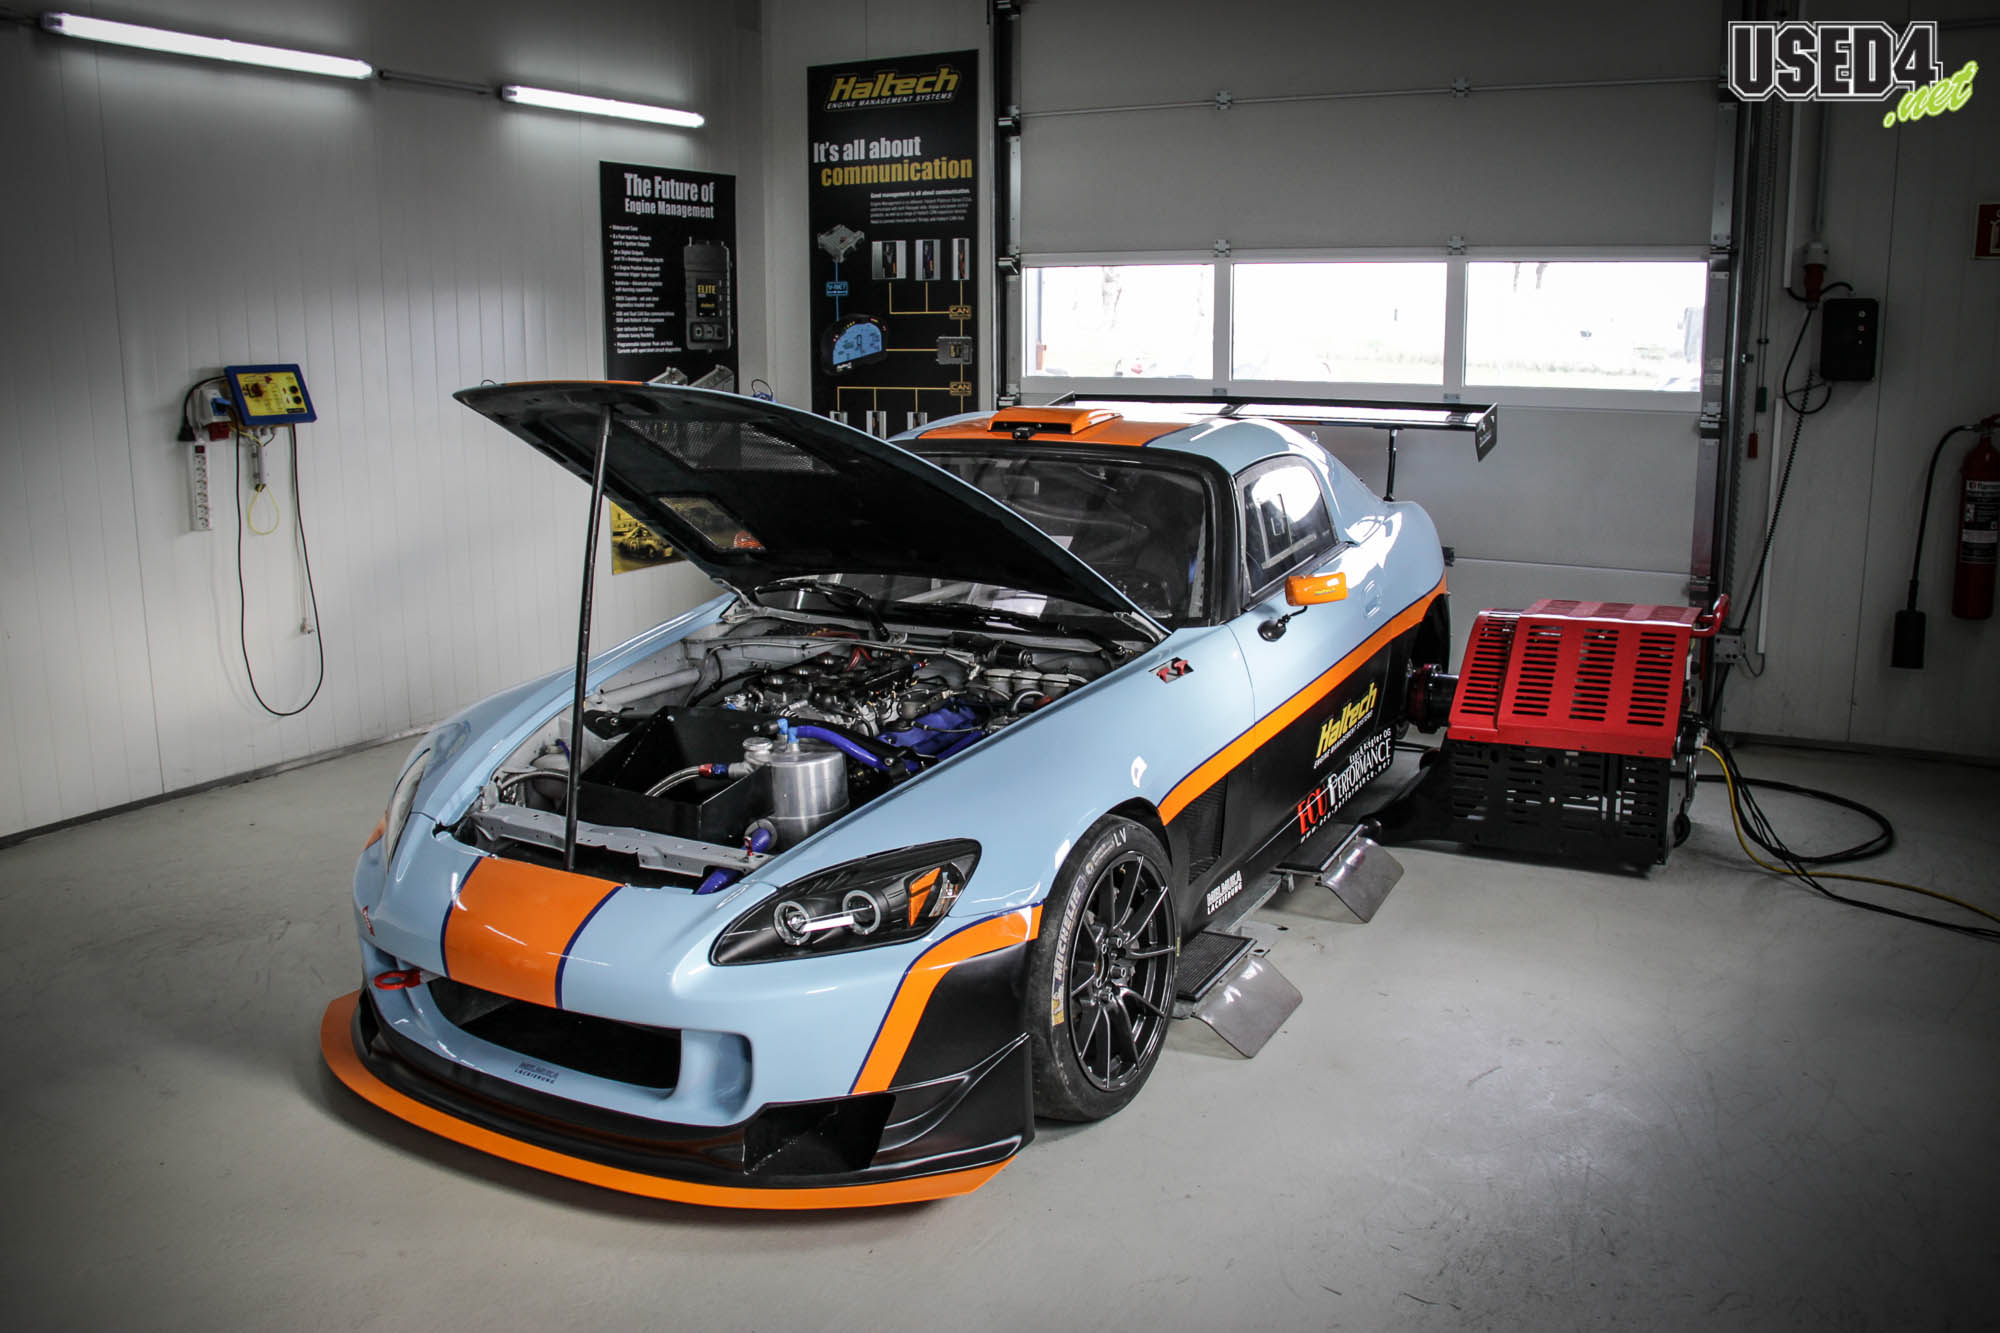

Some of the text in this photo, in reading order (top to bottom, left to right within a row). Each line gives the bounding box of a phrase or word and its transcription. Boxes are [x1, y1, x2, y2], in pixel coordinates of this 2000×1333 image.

[829, 67, 959, 102] Haltech
[827, 92, 953, 110] ENGINE MANAGEMENT SYSTEMS
[813, 136, 922, 163] It's all about
[821, 156, 973, 187] communication
[624, 173, 715, 203] The Future of
[624, 198, 714, 219] Engine Management
[951, 306, 970, 315] CAN
[951, 383, 970, 392] CAN
[1316, 682, 1378, 759] Haltech
[1328, 738, 1392, 807] PERFORMANCE
[1113, 827, 1127, 847] LV
[1054, 886, 1083, 981] MICHELIN
